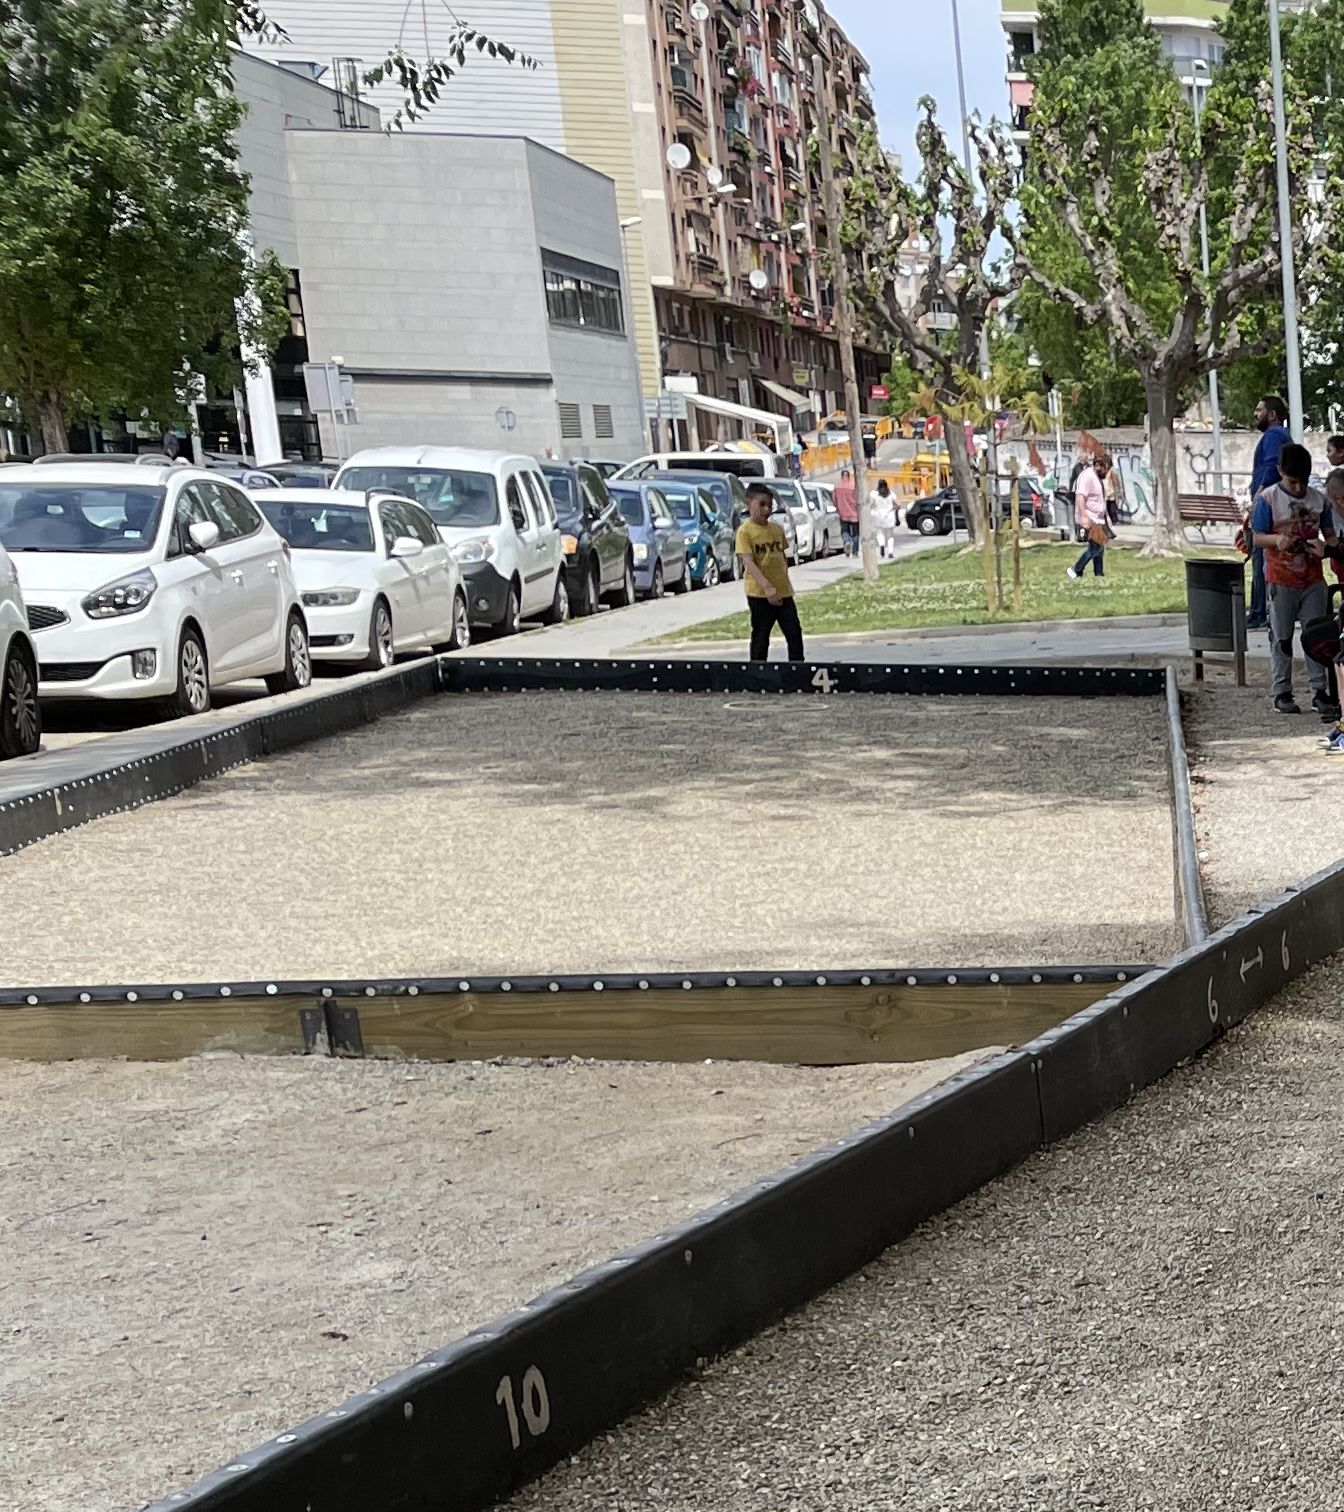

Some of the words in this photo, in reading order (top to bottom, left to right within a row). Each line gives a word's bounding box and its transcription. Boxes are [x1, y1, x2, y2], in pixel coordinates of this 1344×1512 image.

[811, 668, 834, 694] 4
[1207, 976, 1218, 1024] 6
[1281, 930, 1290, 971] 6
[496, 1364, 550, 1450] 10
